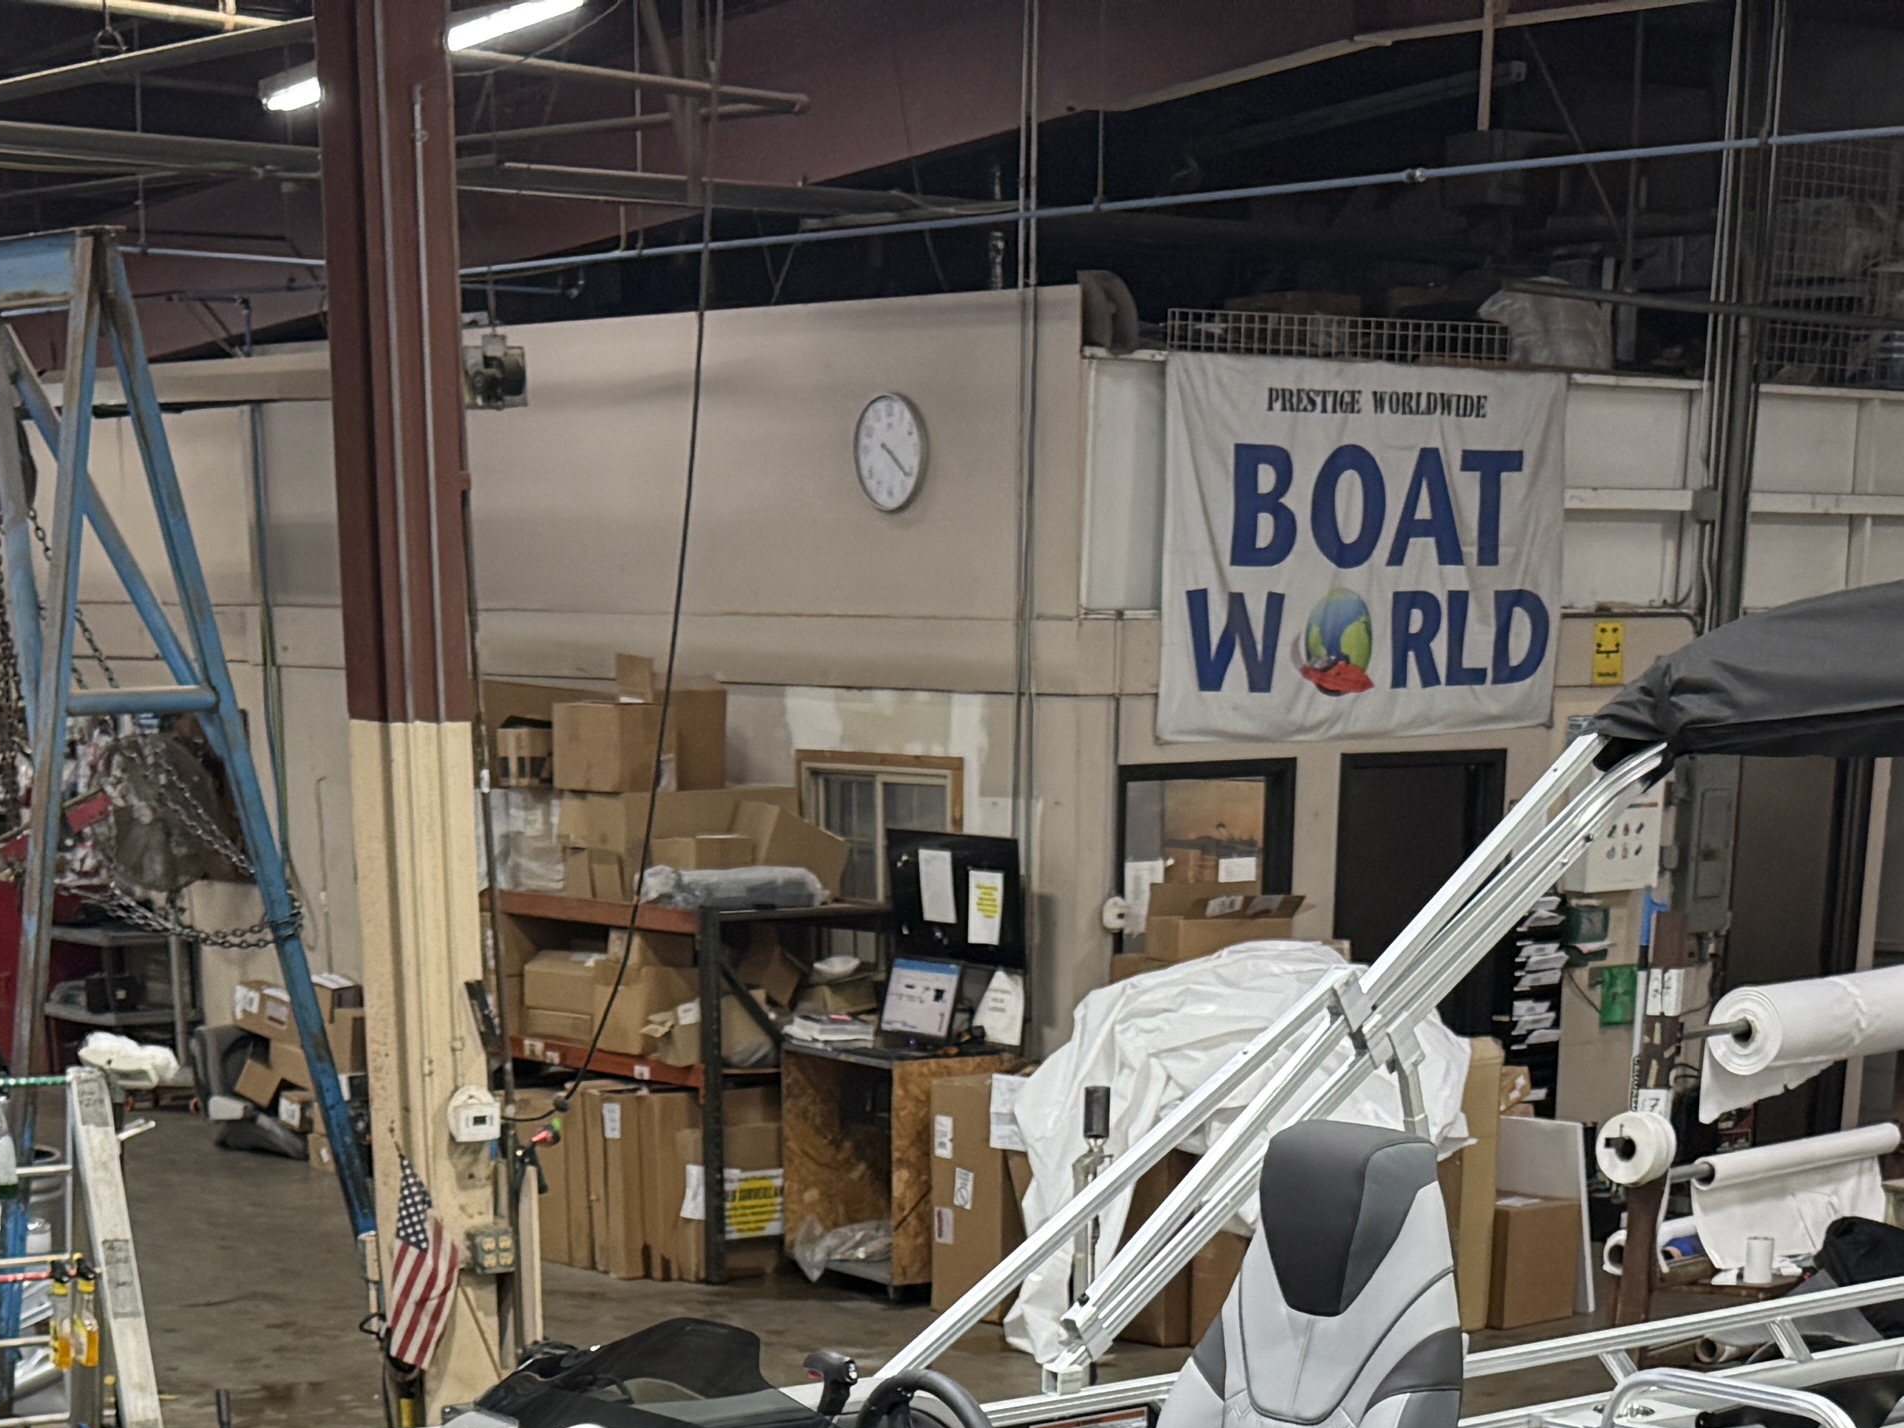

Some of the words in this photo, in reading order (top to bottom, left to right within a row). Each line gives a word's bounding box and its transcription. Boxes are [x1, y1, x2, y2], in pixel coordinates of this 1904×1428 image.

[1265, 386, 1363, 415] PRESTIGE
[1370, 390, 1489, 418] WORLDWIDE
[1229, 442, 1524, 569] BOAT
